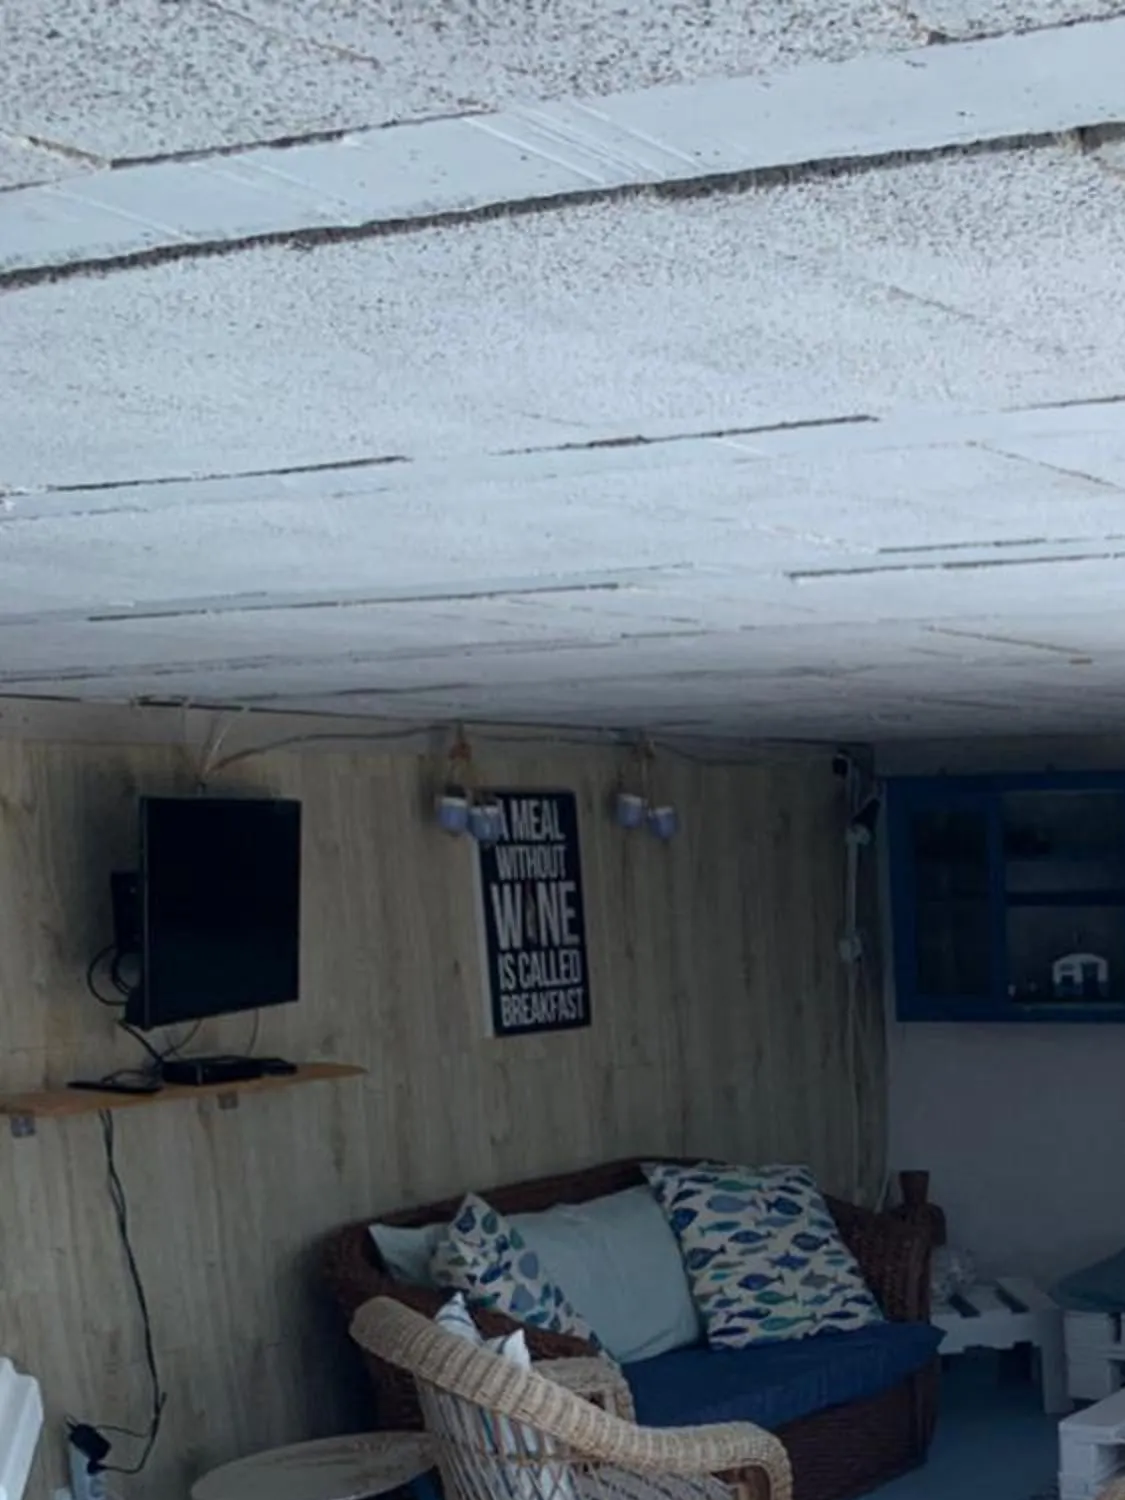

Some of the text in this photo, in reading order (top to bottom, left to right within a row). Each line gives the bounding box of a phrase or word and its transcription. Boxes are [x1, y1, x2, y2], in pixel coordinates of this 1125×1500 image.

[511, 799, 565, 841] MEAL
[496, 846, 567, 881] WITHOUT
[490, 881, 580, 949] WINE
[499, 949, 582, 990] IS CALLED
[501, 988, 585, 1028] BREAKFAST
